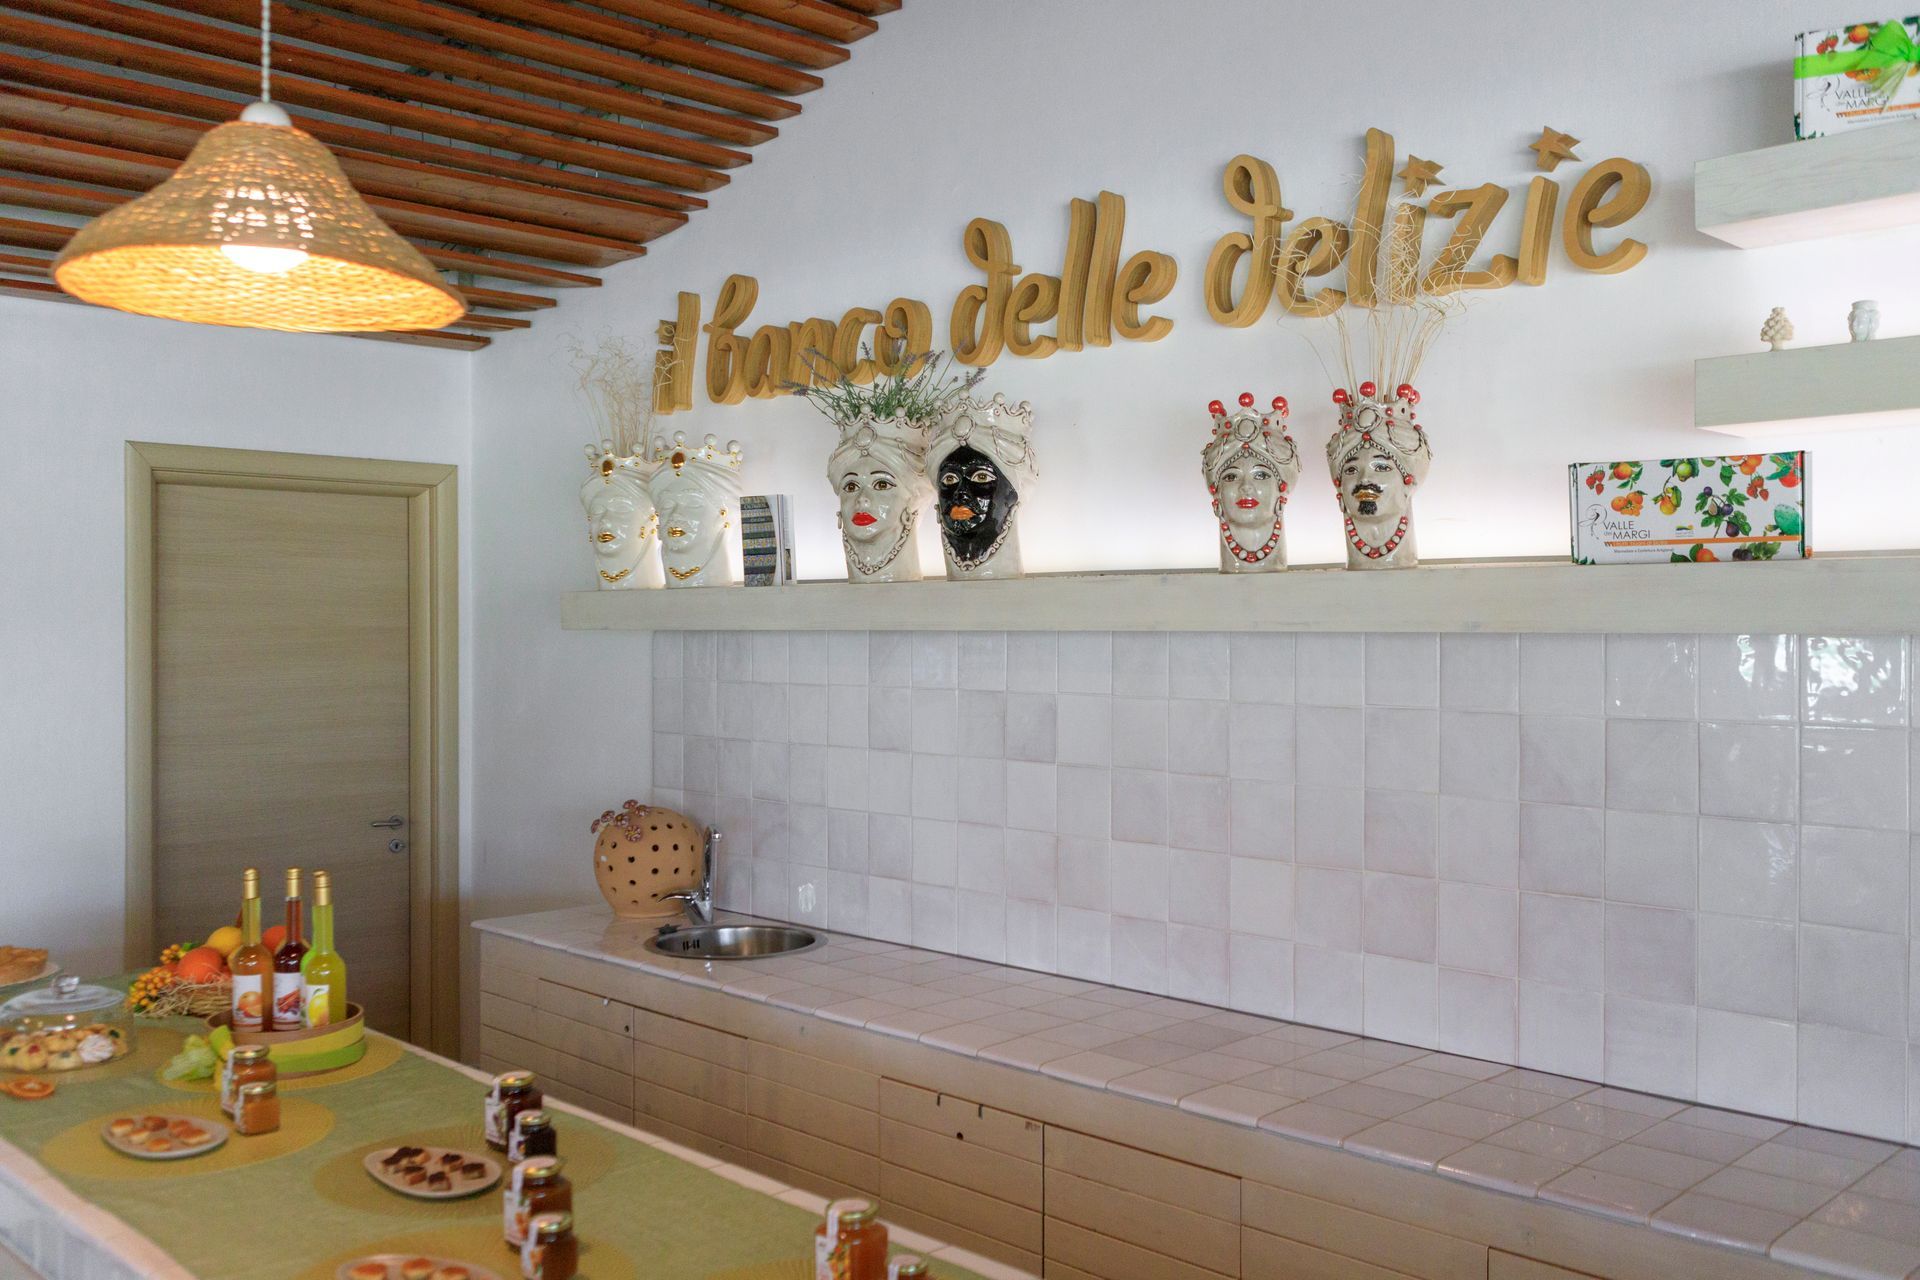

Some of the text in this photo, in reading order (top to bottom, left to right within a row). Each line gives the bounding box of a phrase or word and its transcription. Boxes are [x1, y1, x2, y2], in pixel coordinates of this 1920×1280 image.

[702, 274, 932, 405] banco
[949, 190, 1178, 367] delle
[1203, 125, 1652, 329] delizie
[1603, 520, 1635, 530] VALLE
[1612, 529, 1650, 540] MARGI
